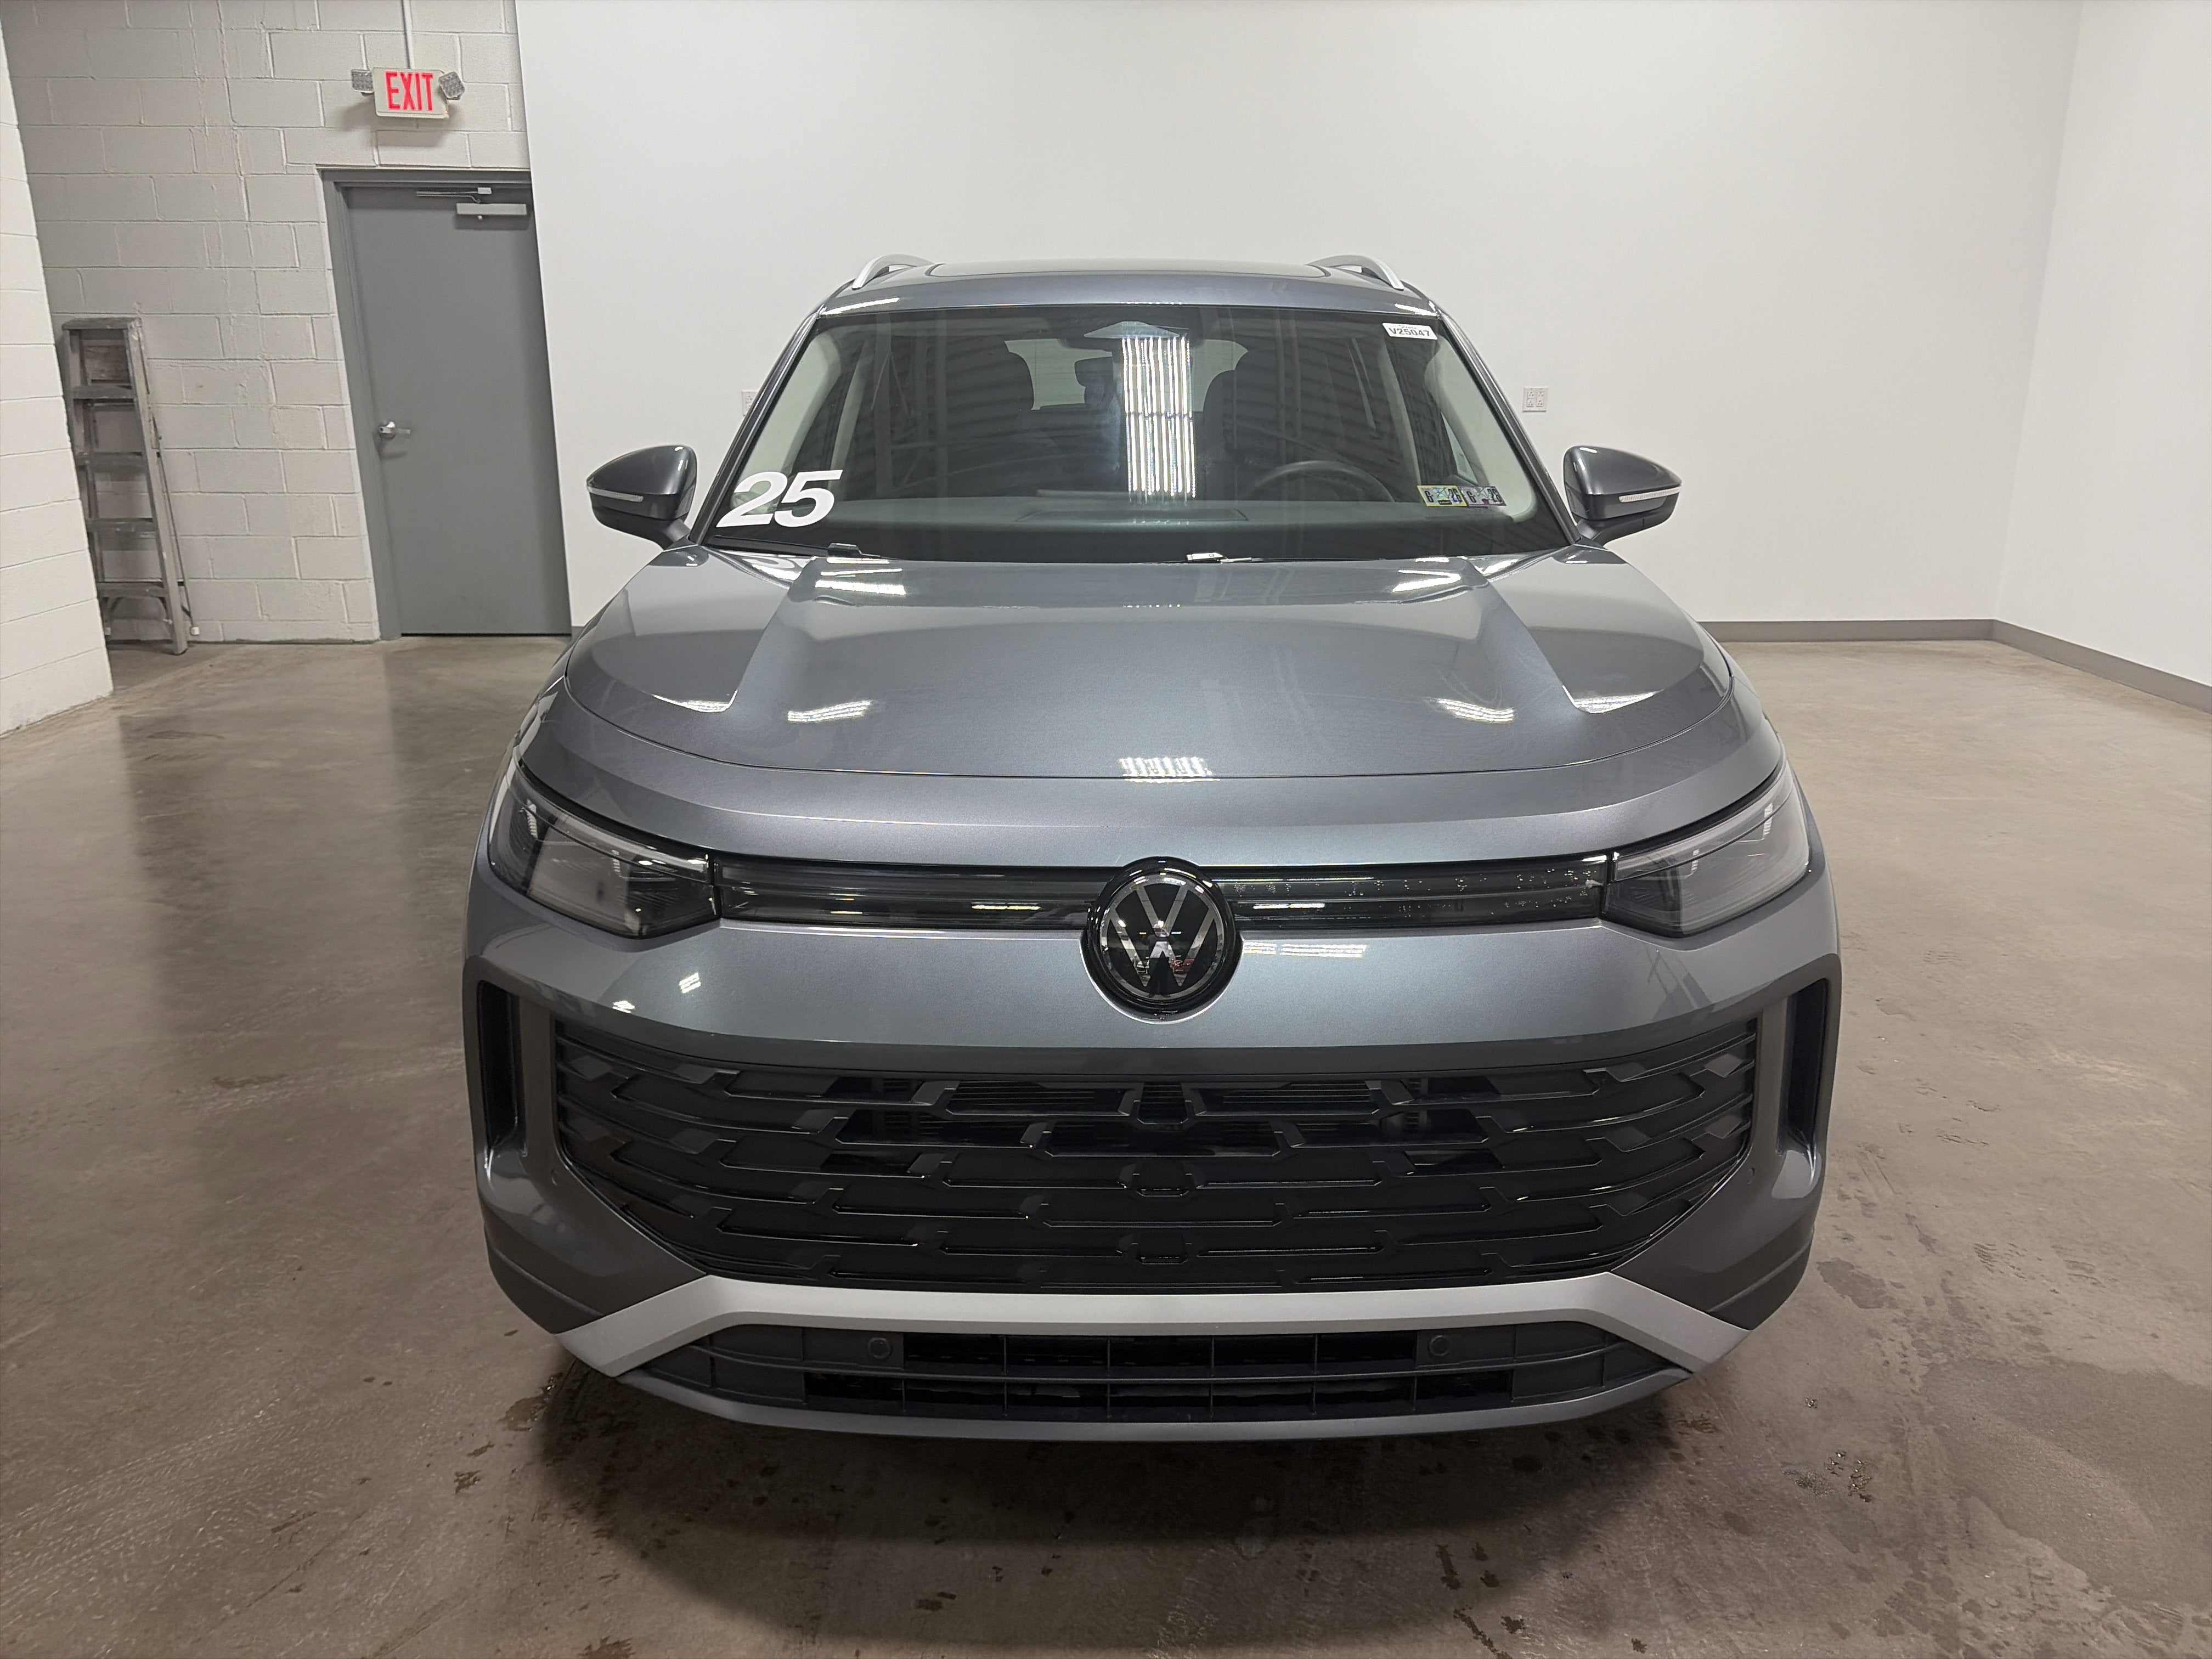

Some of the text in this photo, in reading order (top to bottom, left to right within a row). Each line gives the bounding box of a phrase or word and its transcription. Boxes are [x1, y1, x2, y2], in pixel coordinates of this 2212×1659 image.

[385, 70, 434, 111] EXIT
[1388, 328, 1430, 336] V25047
[716, 470, 843, 528] 25
